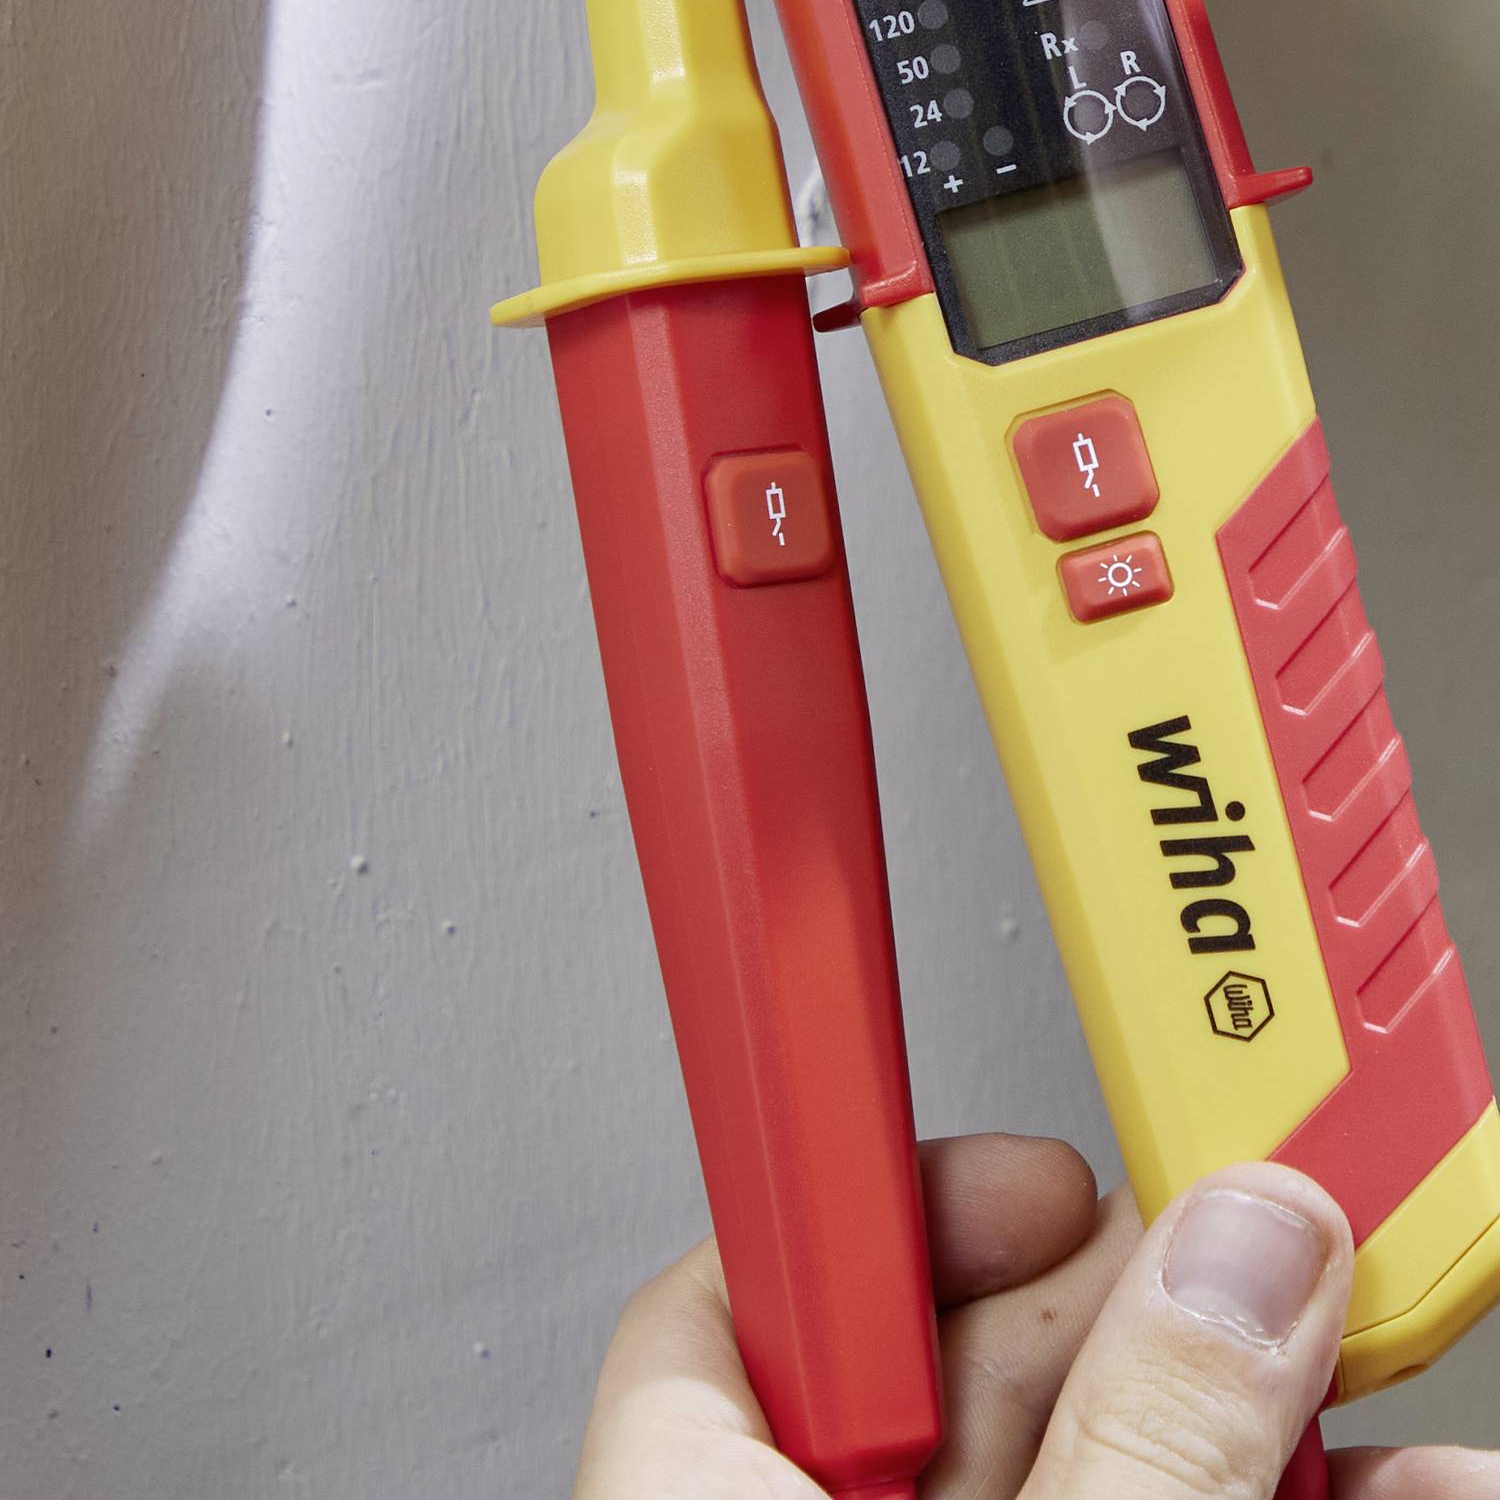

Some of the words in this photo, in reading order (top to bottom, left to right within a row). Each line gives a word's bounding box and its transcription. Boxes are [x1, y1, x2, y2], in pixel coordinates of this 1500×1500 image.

[869, 11, 915, 42] 120
[897, 56, 929, 84] 50
[1067, 64, 1087, 90] L
[1119, 50, 1142, 76] R
[909, 99, 943, 129] 24
[900, 150, 931, 180] 12
[1127, 715, 1256, 954] wiha
